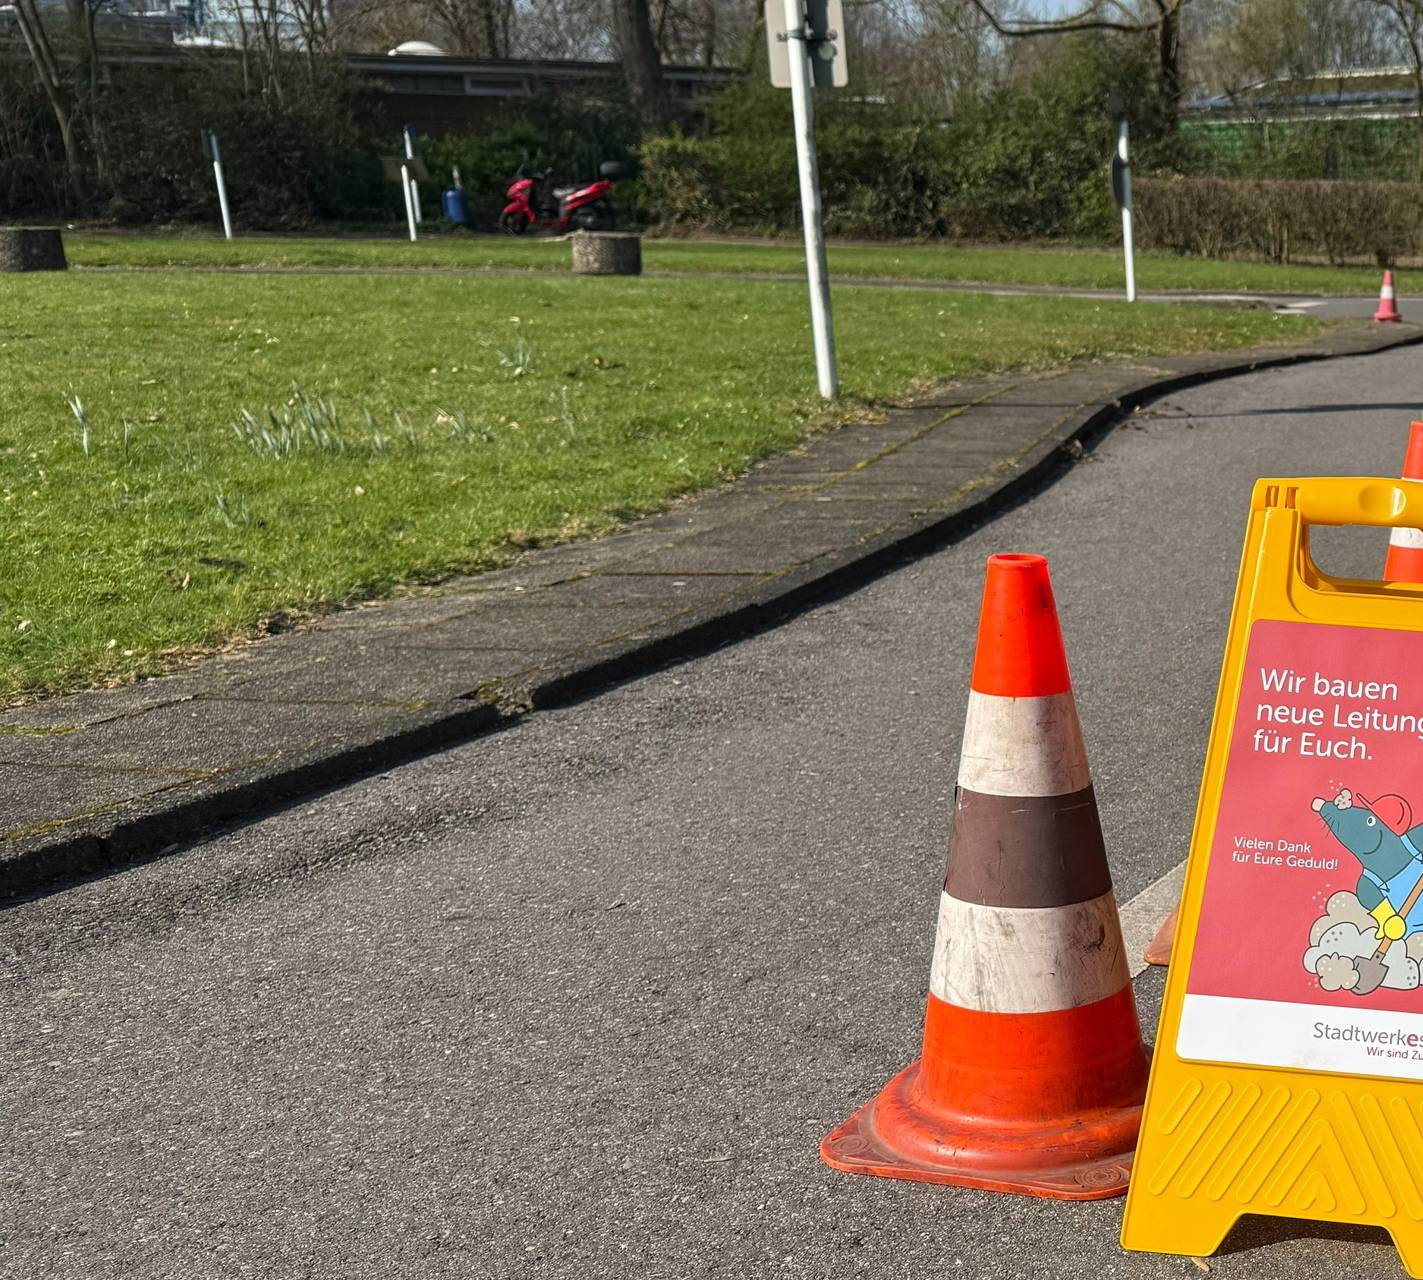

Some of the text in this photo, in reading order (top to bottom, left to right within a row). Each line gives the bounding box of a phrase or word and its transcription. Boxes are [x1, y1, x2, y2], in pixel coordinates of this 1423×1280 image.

[1260, 668, 1398, 700] Wir bauen
[1256, 703, 1324, 726] neue
[1253, 728, 1373, 760] für Euch.
[1234, 836, 1311, 853] Vielen Dank
[1232, 850, 1338, 870] für Eure Geduld!
[1366, 1046, 1385, 1057] Wir
[1387, 1048, 1409, 1060] sind
